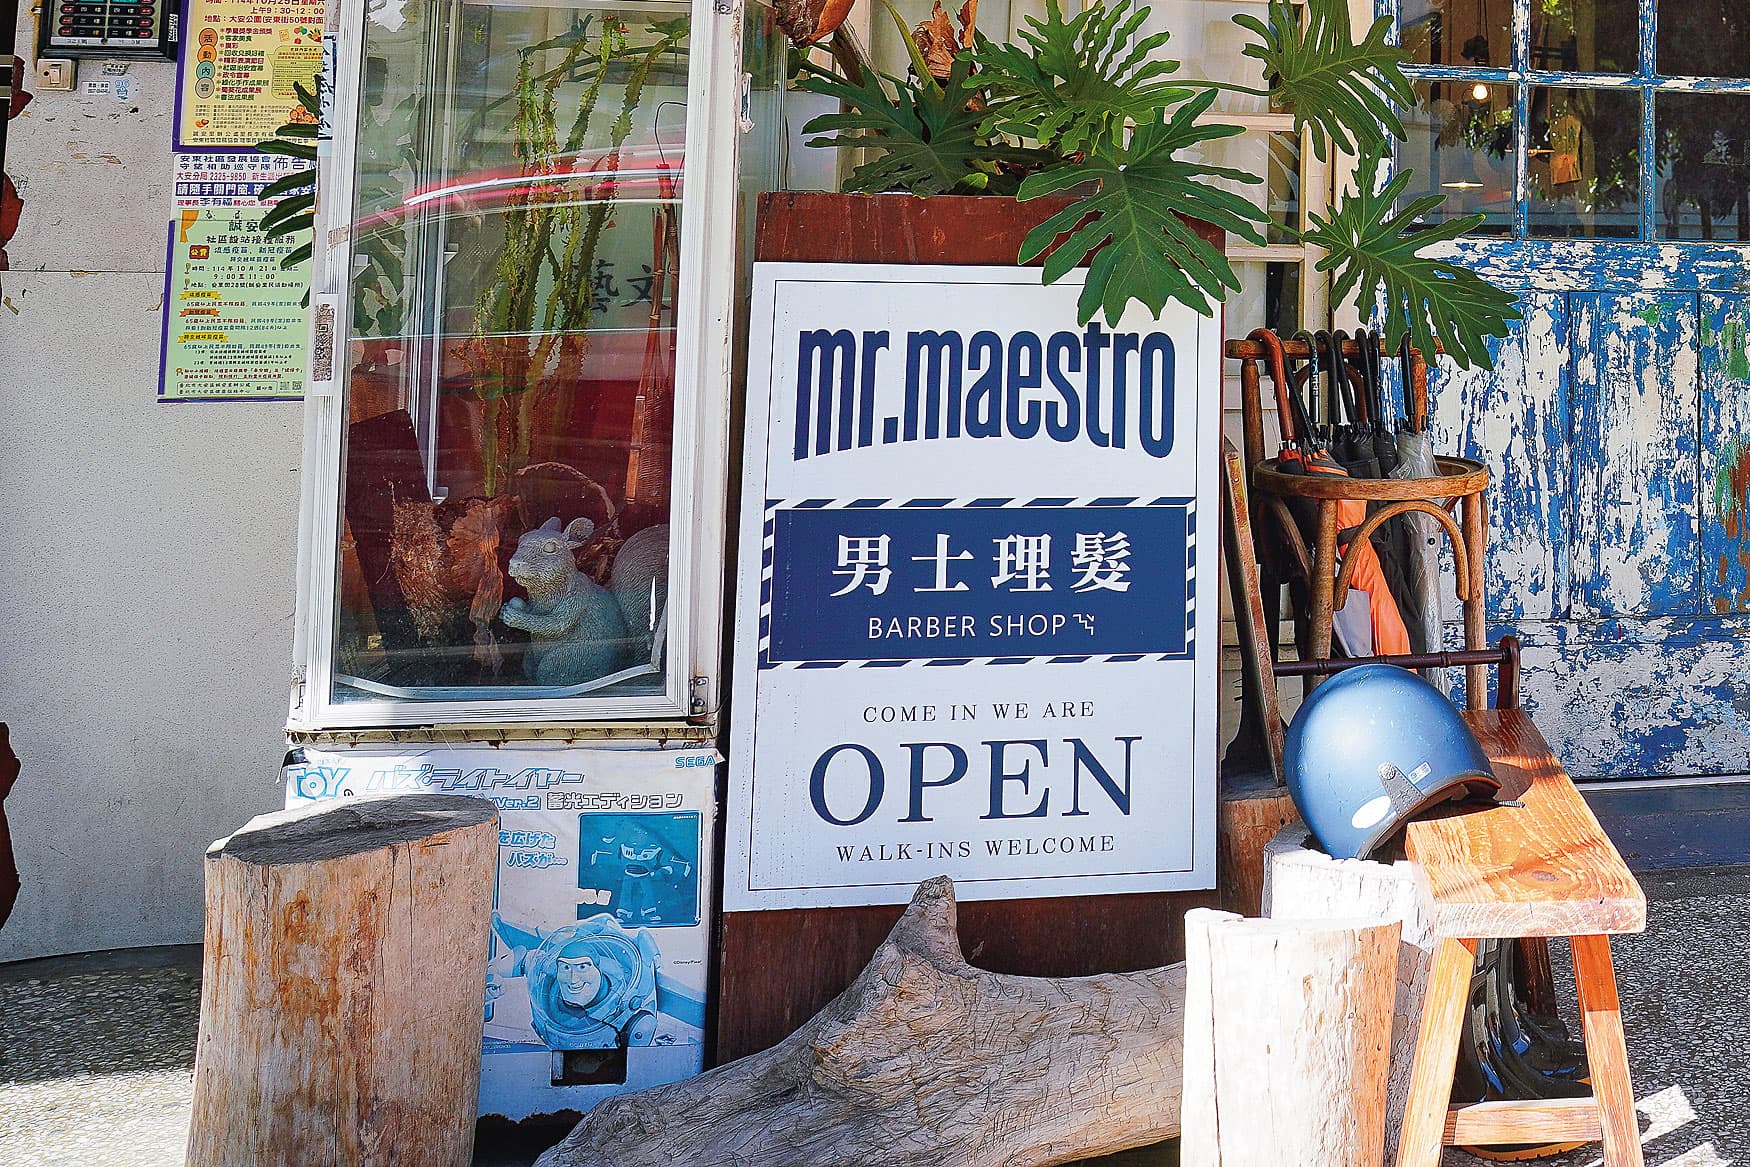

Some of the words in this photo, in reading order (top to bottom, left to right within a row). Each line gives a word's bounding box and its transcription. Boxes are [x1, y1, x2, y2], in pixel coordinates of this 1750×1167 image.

[793, 321, 1177, 461] mr.maestro
[830, 530, 1133, 598] 男士理髮
[867, 615, 976, 639] BARBER
[989, 613, 1067, 637] SHOP
[863, 703, 937, 724] COME
[950, 703, 979, 721] IN
[993, 701, 1029, 720] WE
[1043, 700, 1096, 719] ARE
[674, 755, 716, 768] SEGA
[808, 736, 1143, 827] OPEN
[546, 792, 684, 810] 蓄光エディション
[836, 840, 971, 862] WALK-INS
[984, 835, 1116, 858] WELCOME
